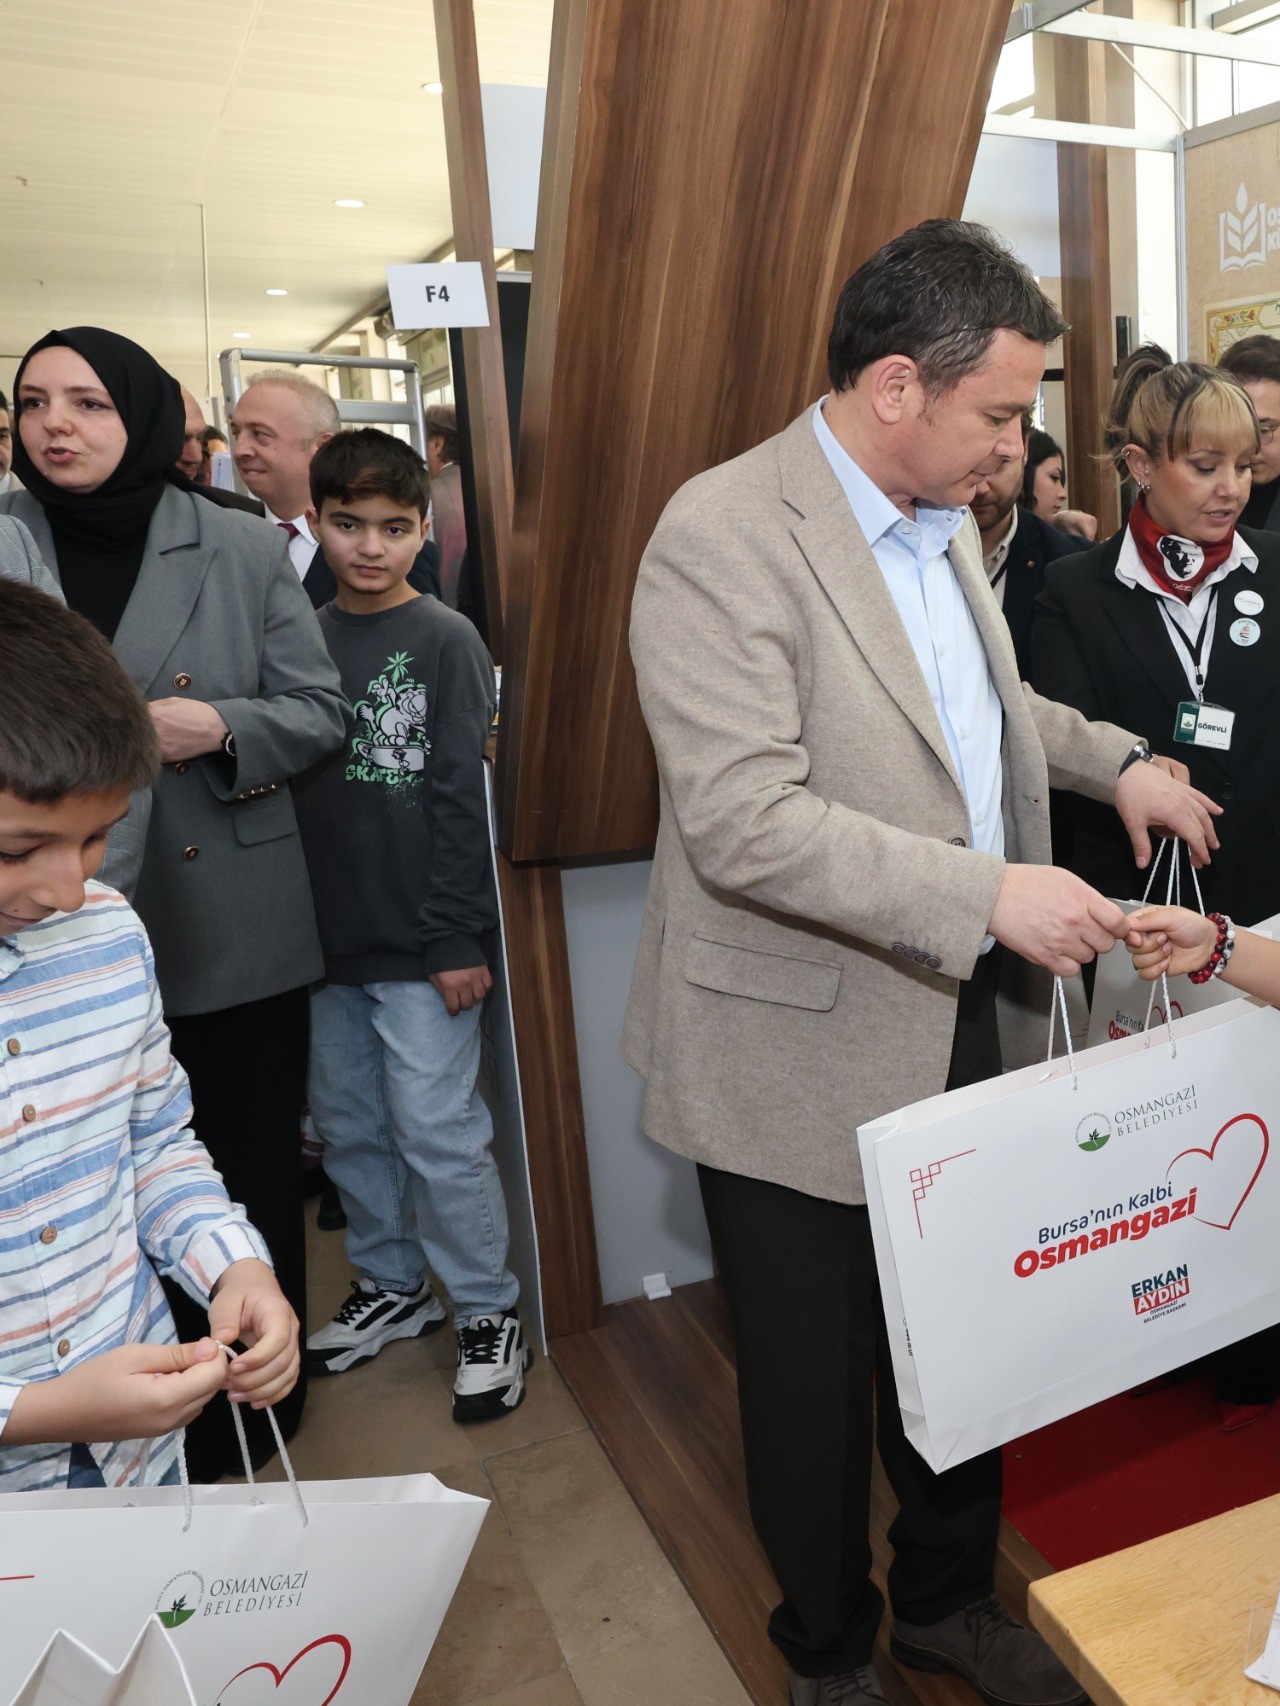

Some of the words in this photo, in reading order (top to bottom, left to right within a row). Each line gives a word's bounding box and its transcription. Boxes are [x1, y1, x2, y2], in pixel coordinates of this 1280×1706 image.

[425, 285, 450, 303] F4
[1197, 722, 1227, 733] GÖREVLİ
[1114, 1084, 1197, 1124] OSMANGAZİ
[1117, 1099, 1198, 1137] BELEDİYESİ
[1128, 1181, 1173, 1211] Kalbi
[1013, 1187, 1197, 1278] Osmangazi
[1131, 1263, 1188, 1298] ERKAN
[1135, 1279, 1188, 1314] AYDIN
[210, 1571, 308, 1597] OSMANGAZİ
[203, 1592, 302, 1616] BELEDİYESİ
